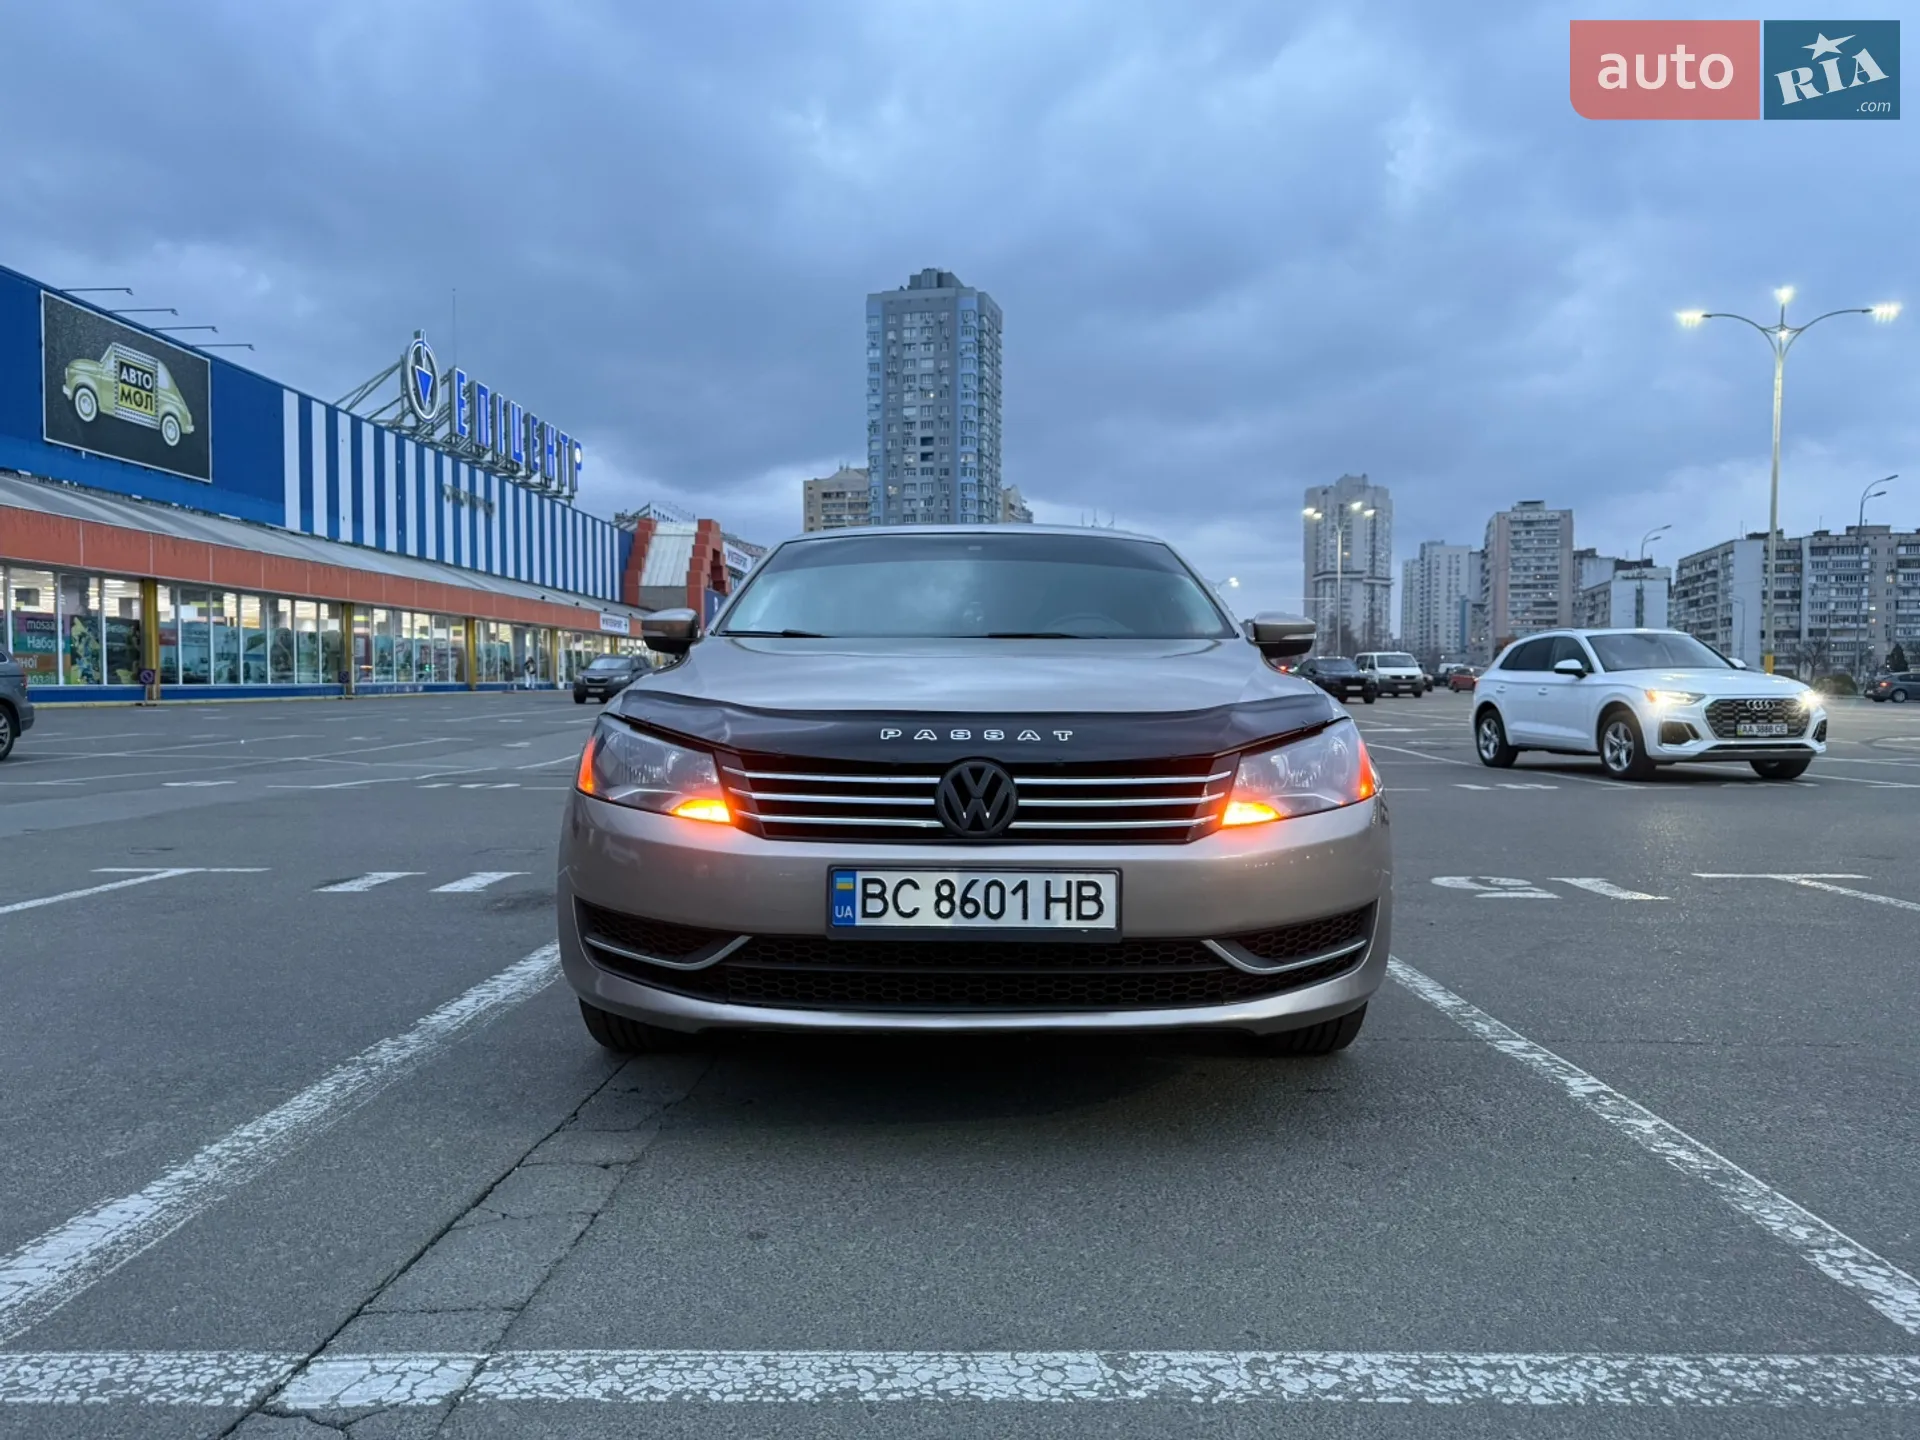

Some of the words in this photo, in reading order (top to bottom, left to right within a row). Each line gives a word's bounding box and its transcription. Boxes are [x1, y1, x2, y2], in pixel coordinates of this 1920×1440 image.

[121, 365, 152, 389] АВТО
[120, 386, 153, 411] МОЛ
[450, 366, 583, 492] ЕПІЦЕНТР
[880, 728, 1073, 741] PASSAT
[860, 877, 921, 920] BC
[933, 878, 1030, 921] 8601
[1044, 879, 1106, 922] HB
[834, 905, 854, 920] UA
